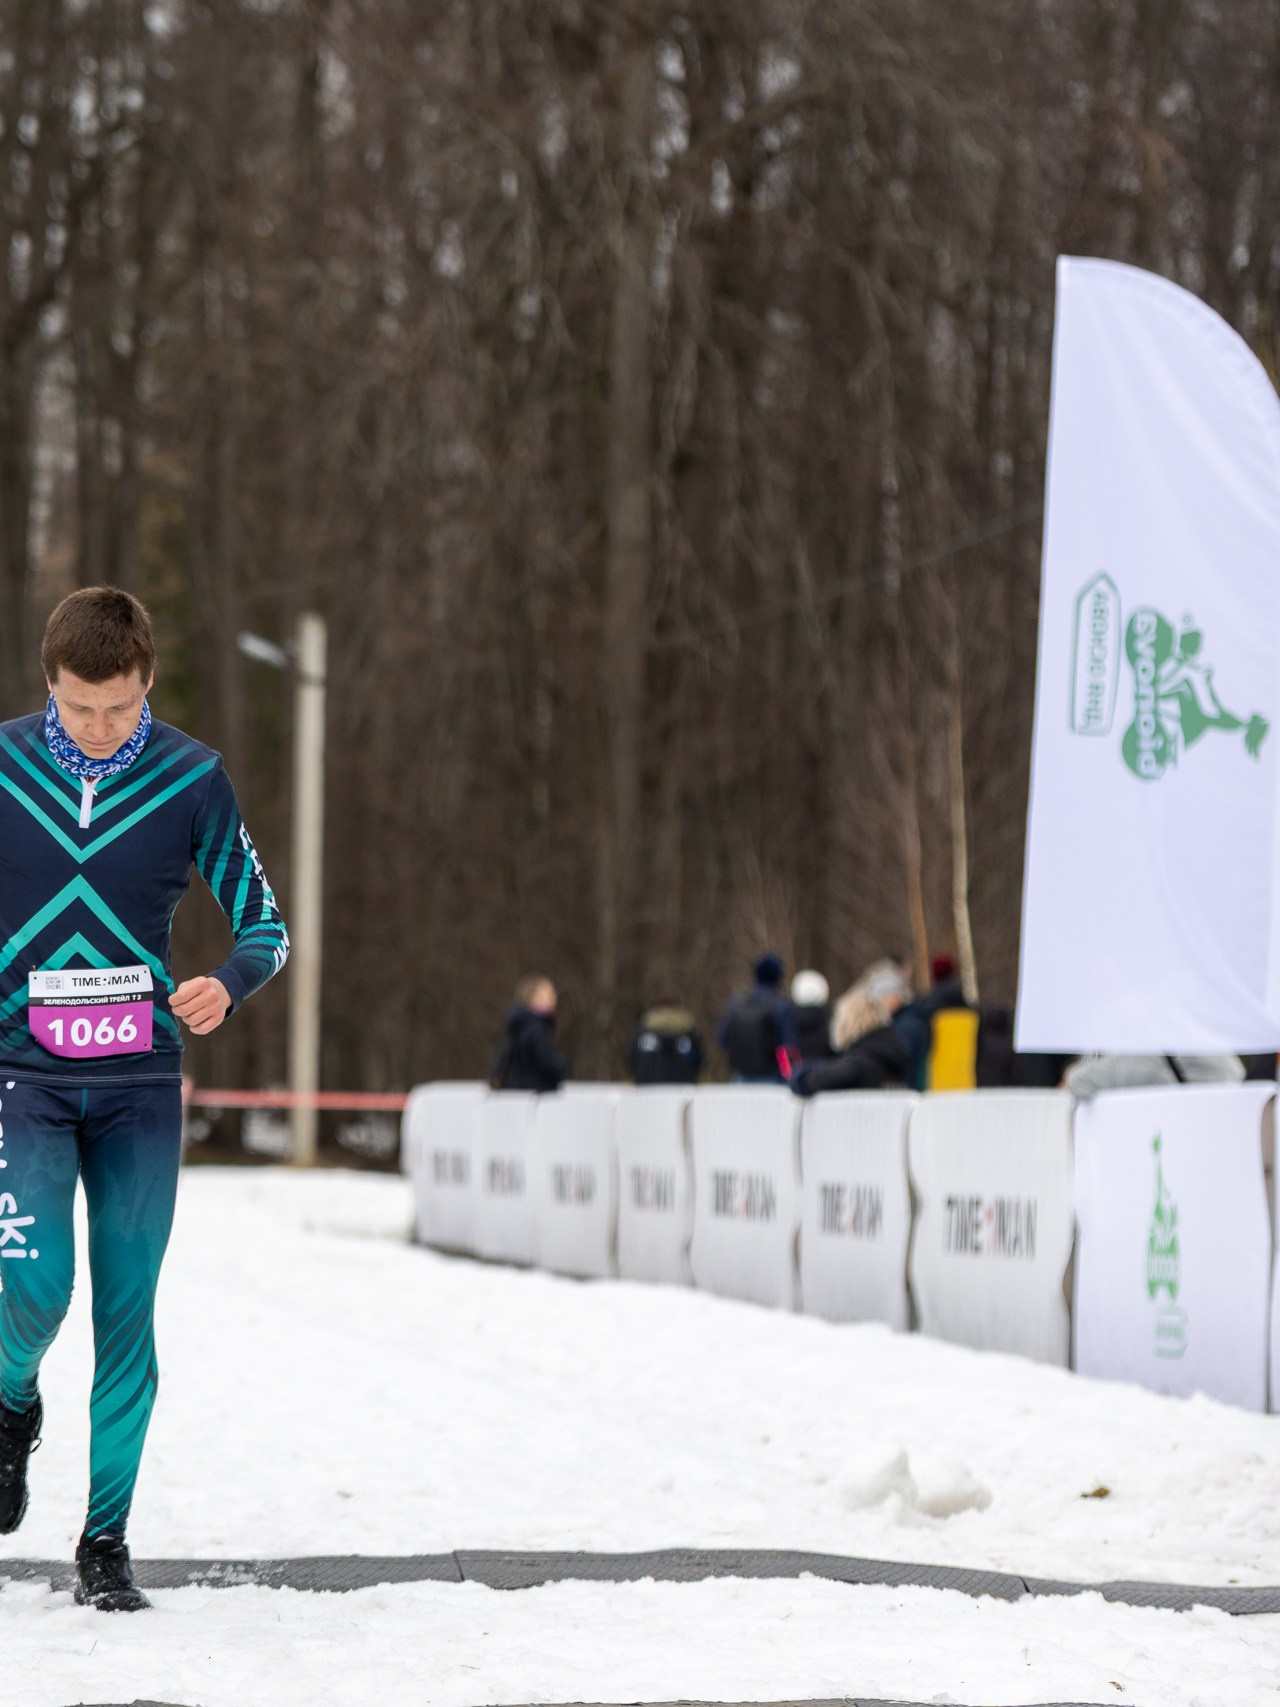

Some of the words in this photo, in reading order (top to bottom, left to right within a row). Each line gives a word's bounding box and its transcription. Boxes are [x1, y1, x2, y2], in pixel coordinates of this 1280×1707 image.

[43, 996, 109, 1005] ЗЕЛЕНОДОЛЬСКИЙ
[109, 994, 130, 1003] ТРЕЙЛ
[47, 1014, 138, 1047] 1066
